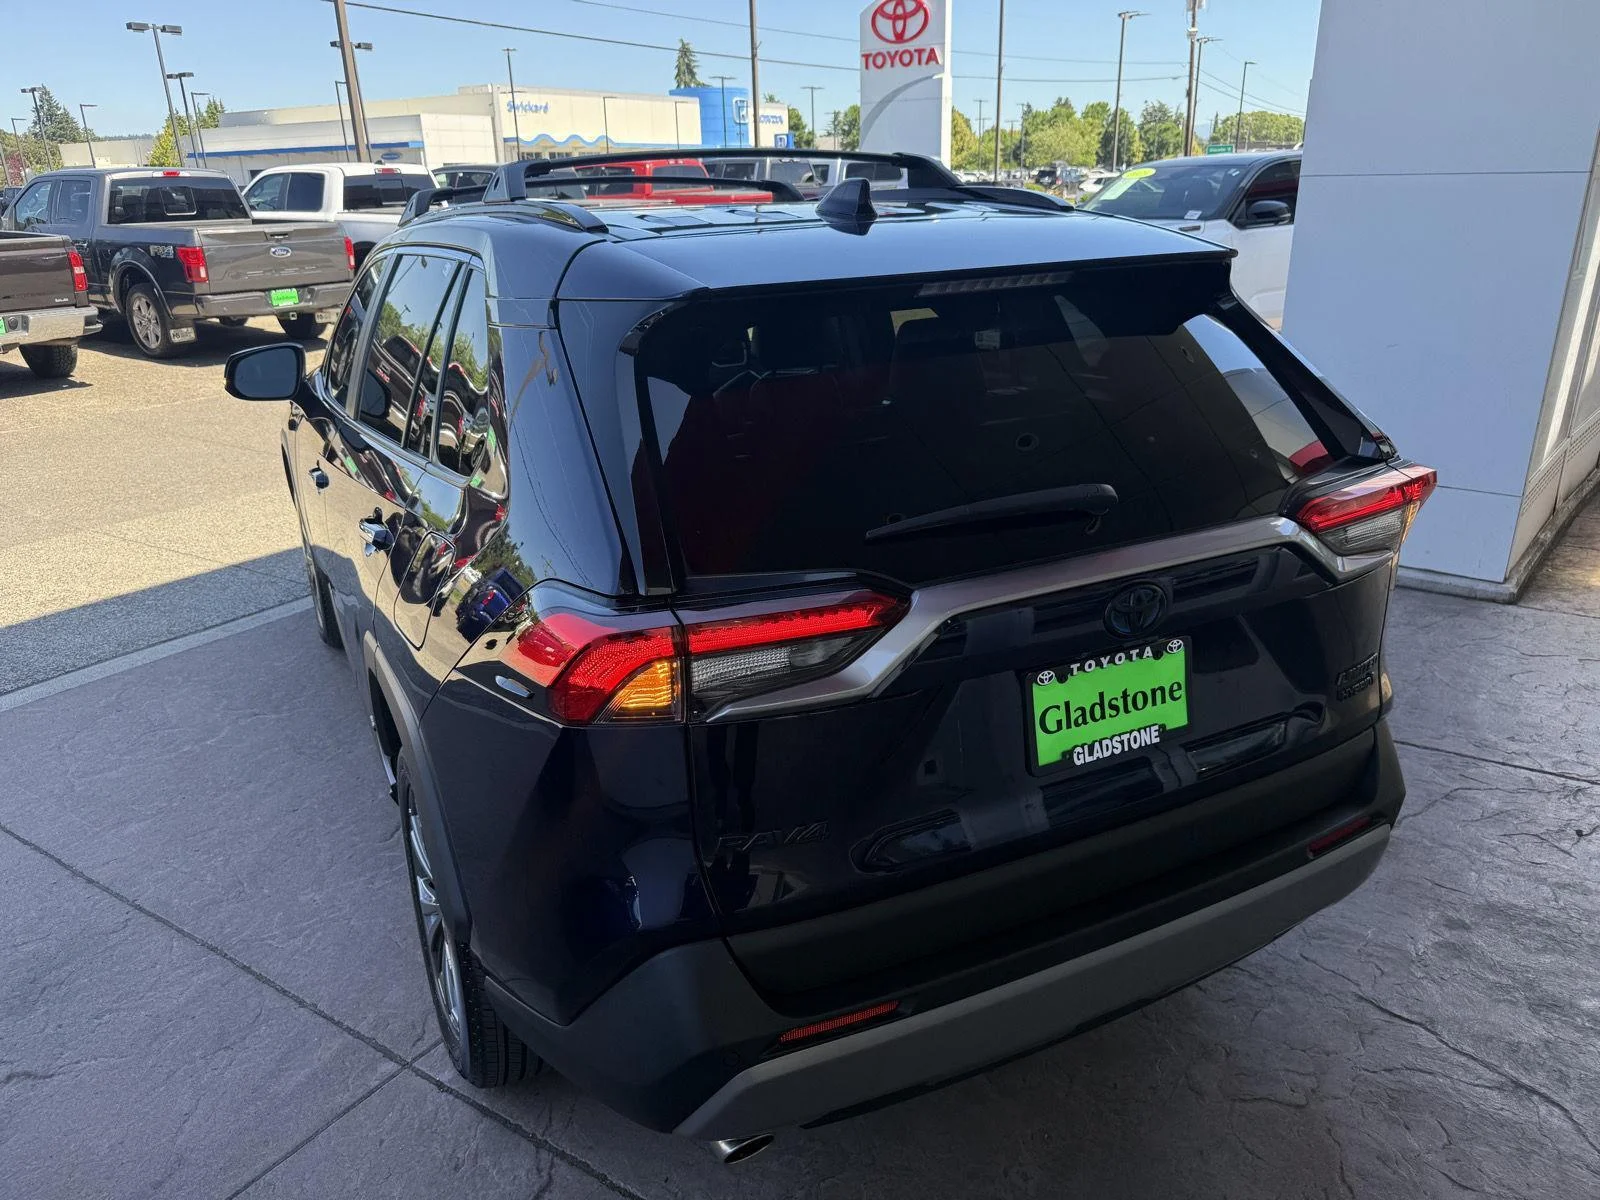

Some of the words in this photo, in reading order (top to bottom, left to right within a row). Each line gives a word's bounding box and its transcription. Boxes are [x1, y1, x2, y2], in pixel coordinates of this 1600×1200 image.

[861, 47, 940, 70] TOYOTA
[1070, 647, 1153, 675] TOYOTA
[1038, 681, 1183, 735] Gladstone
[1073, 725, 1160, 766] GLADSTONE
[713, 820, 829, 855] RAV4
